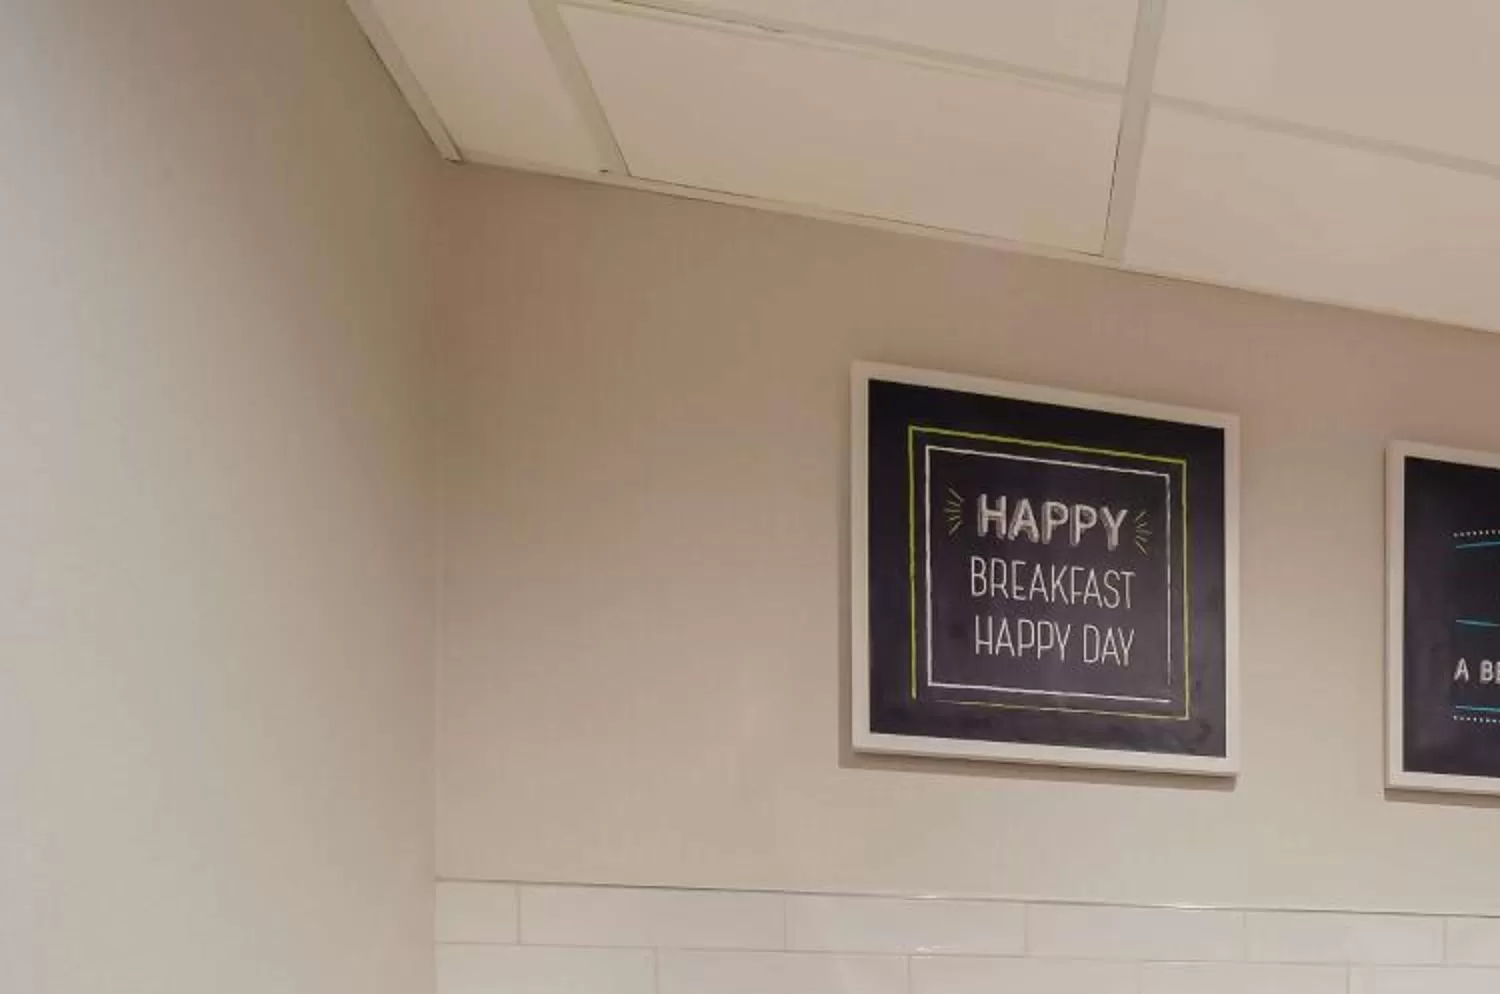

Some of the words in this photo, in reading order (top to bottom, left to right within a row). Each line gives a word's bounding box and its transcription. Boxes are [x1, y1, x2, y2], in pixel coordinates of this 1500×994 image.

[976, 493, 1128, 551] HAPPY
[970, 554, 1136, 609] BREAKFAST
[975, 614, 1071, 661] HAPPY
[1083, 623, 1135, 666] DAY
[1454, 657, 1470, 682] A
